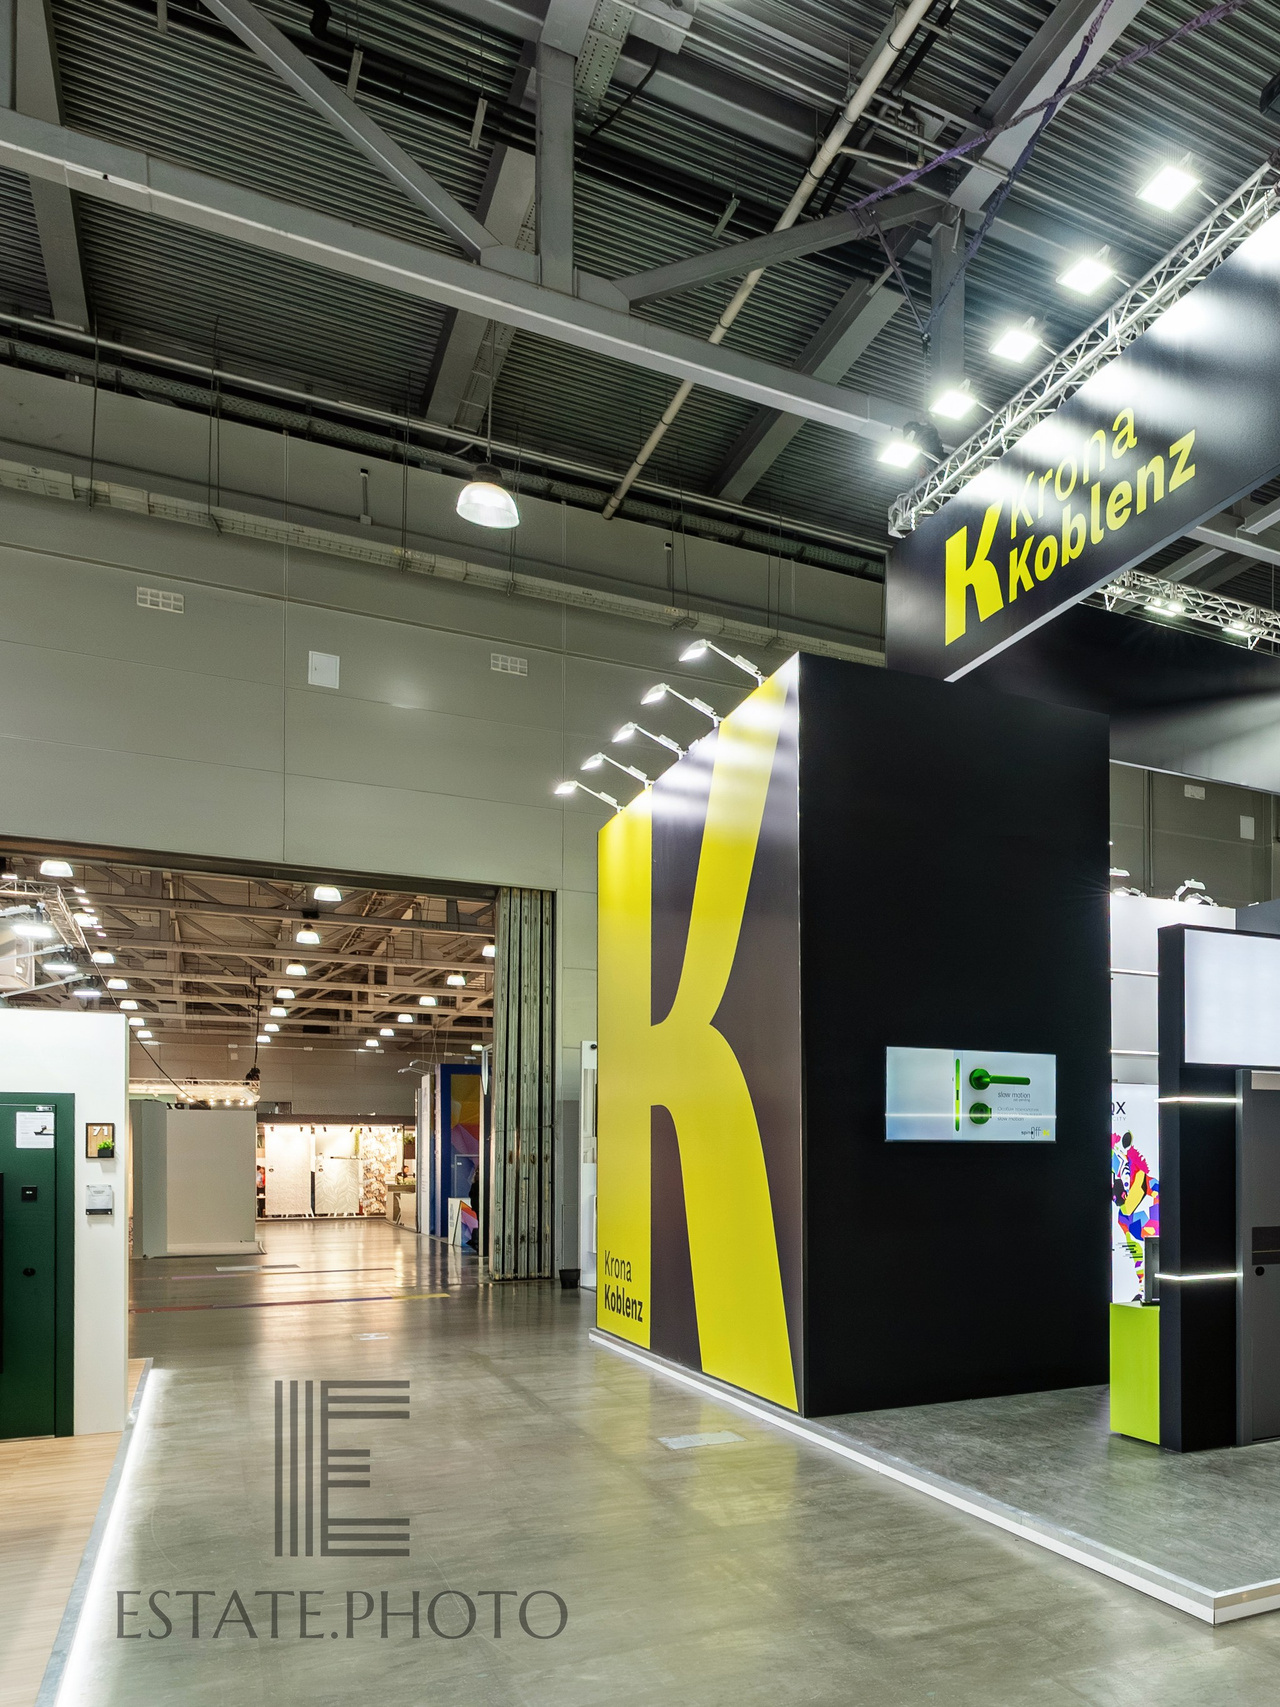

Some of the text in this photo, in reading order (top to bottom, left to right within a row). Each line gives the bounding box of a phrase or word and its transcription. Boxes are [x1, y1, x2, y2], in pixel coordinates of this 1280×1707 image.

[1009, 429, 1196, 603] Koblenz
[1010, 407, 1138, 540] Krona
[945, 494, 1004, 646] K
[92, 1126, 109, 1136] 71
[604, 1250, 632, 1283] Krona
[604, 1284, 643, 1323] Koblenz
